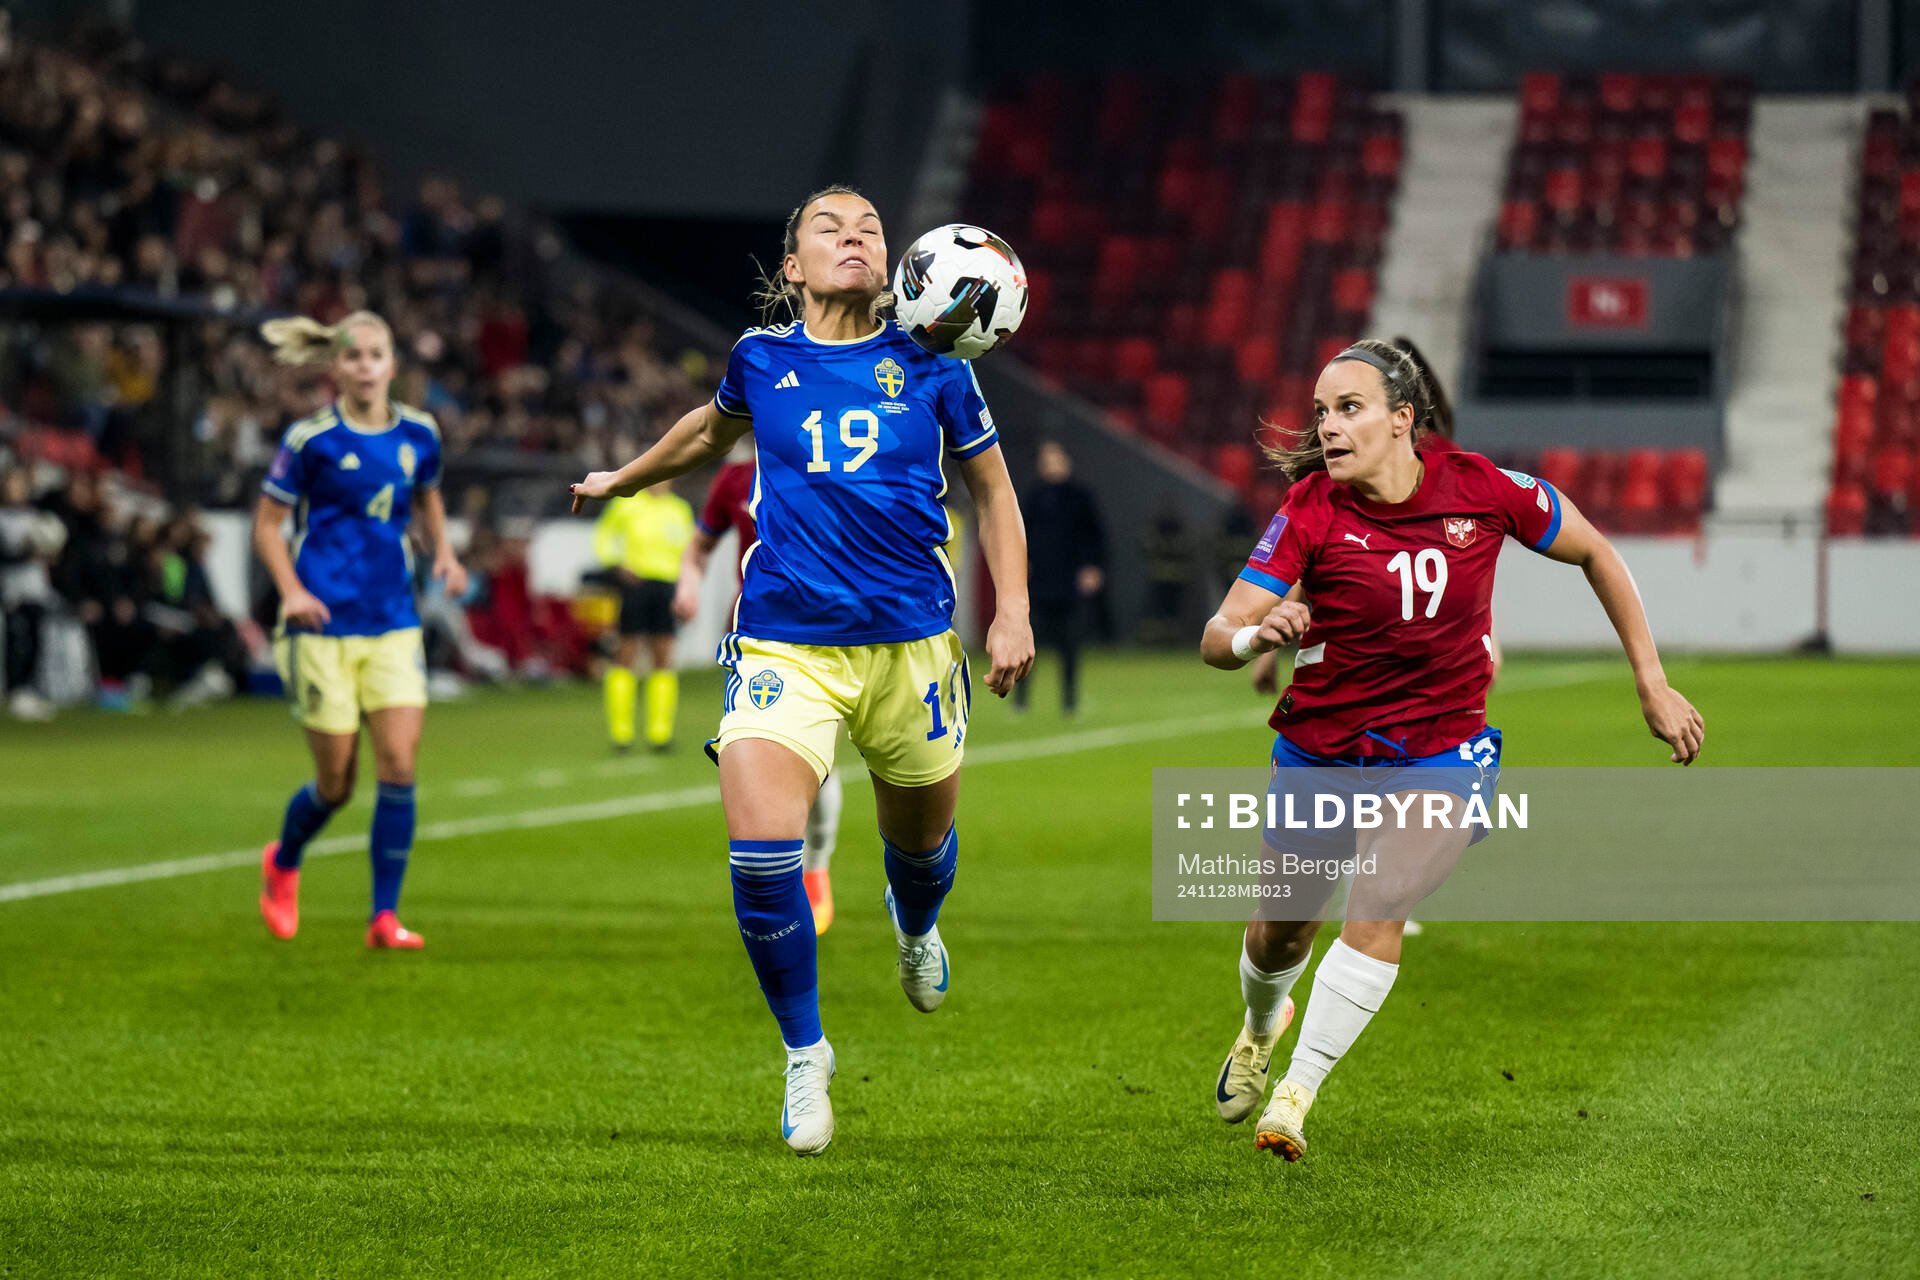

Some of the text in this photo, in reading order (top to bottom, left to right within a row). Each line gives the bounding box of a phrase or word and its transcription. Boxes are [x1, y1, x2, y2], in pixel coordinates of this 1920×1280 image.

[801, 409, 879, 473] 19
[366, 483, 395, 523] 4
[1387, 548, 1448, 621] 19
